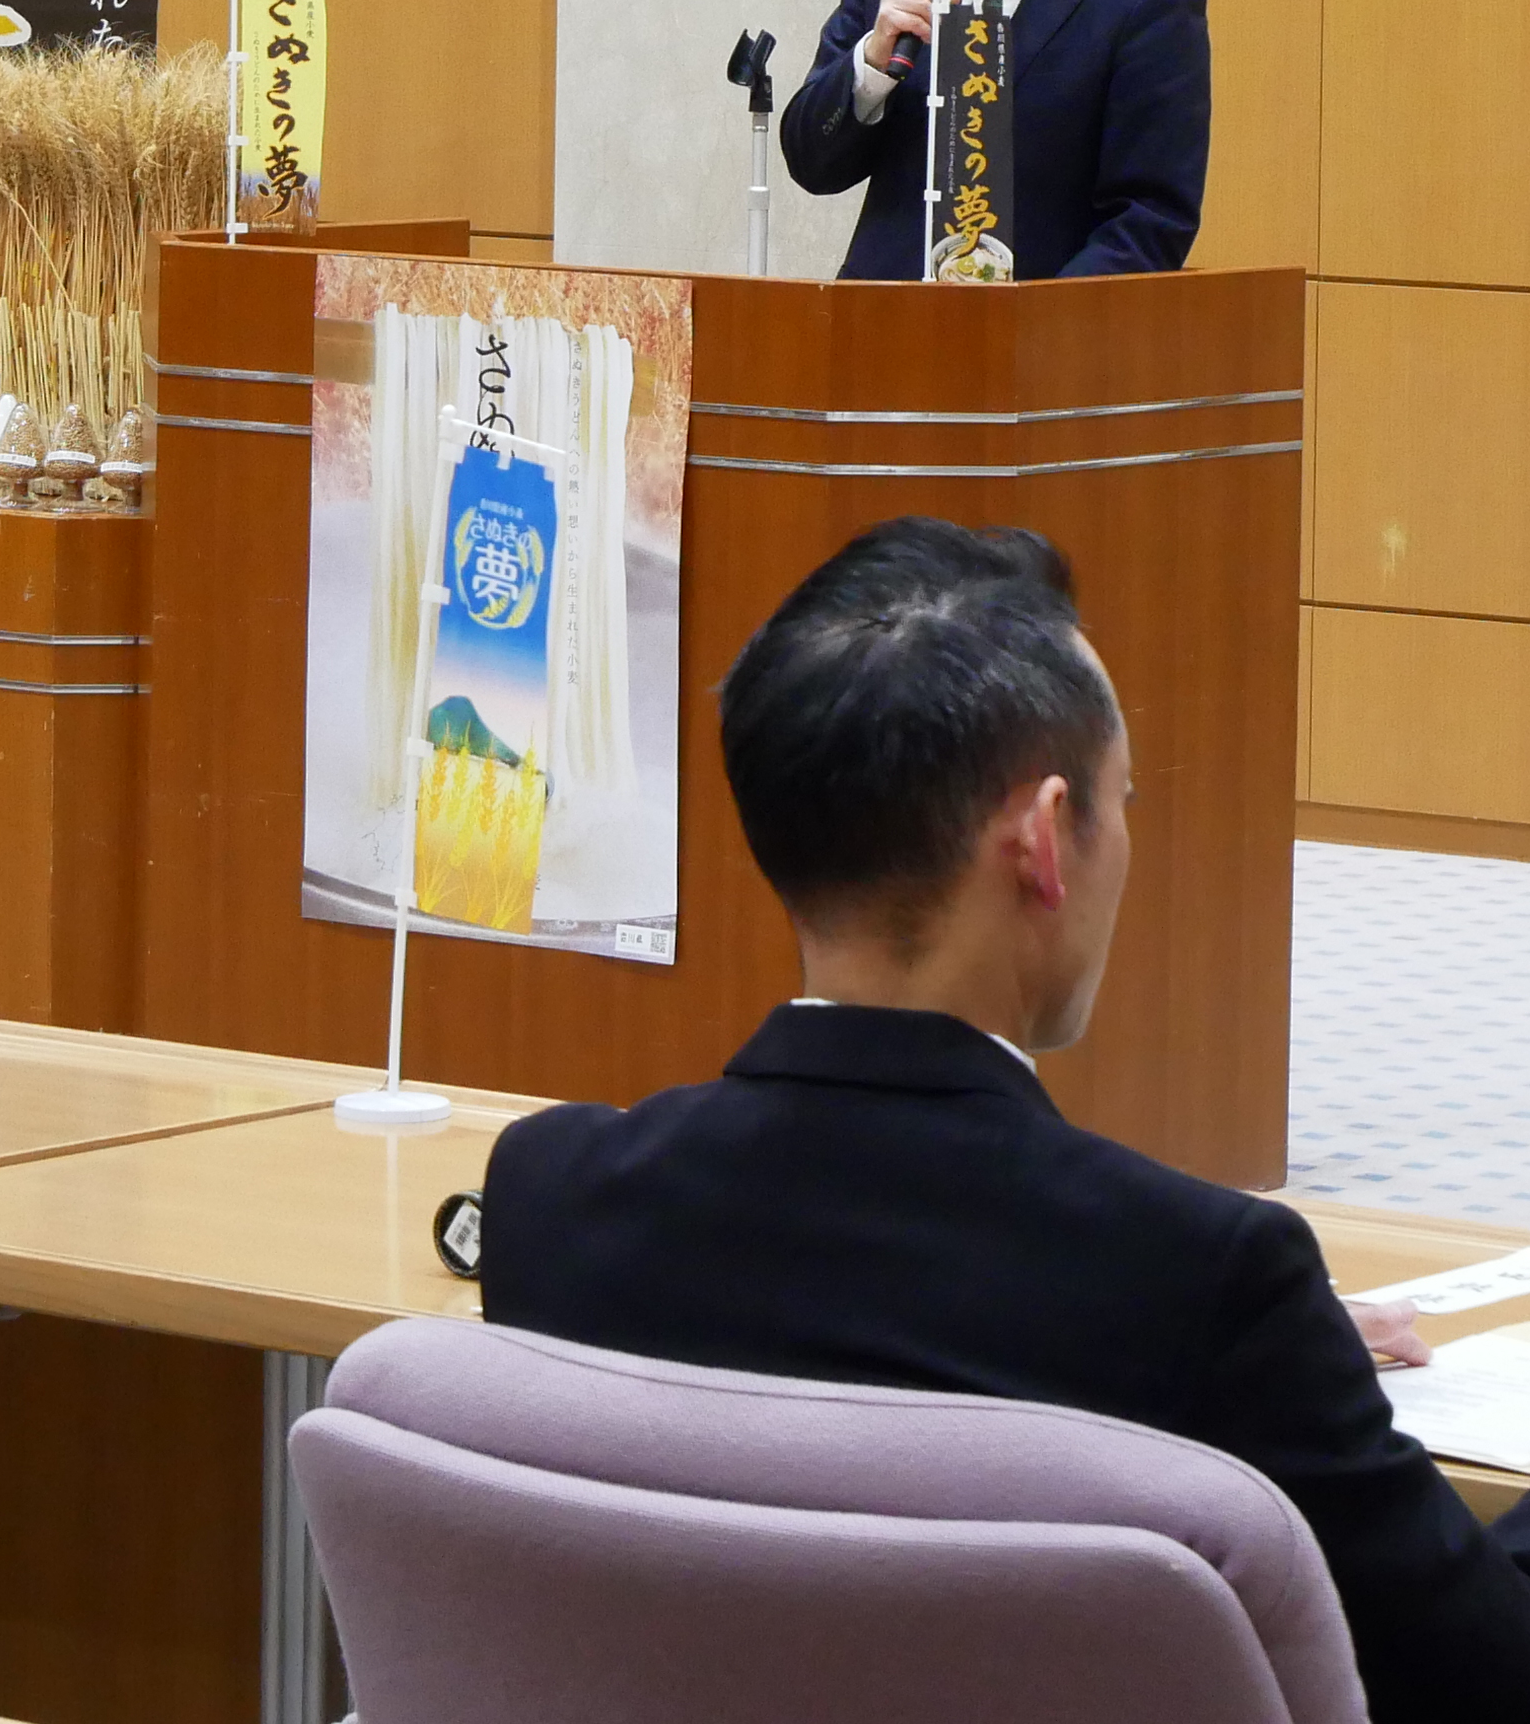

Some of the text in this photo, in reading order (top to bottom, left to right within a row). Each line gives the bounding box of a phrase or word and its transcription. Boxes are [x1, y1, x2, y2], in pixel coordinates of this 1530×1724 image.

[944, 19, 999, 260] さぬきの夢
[472, 542, 522, 618] 夢
